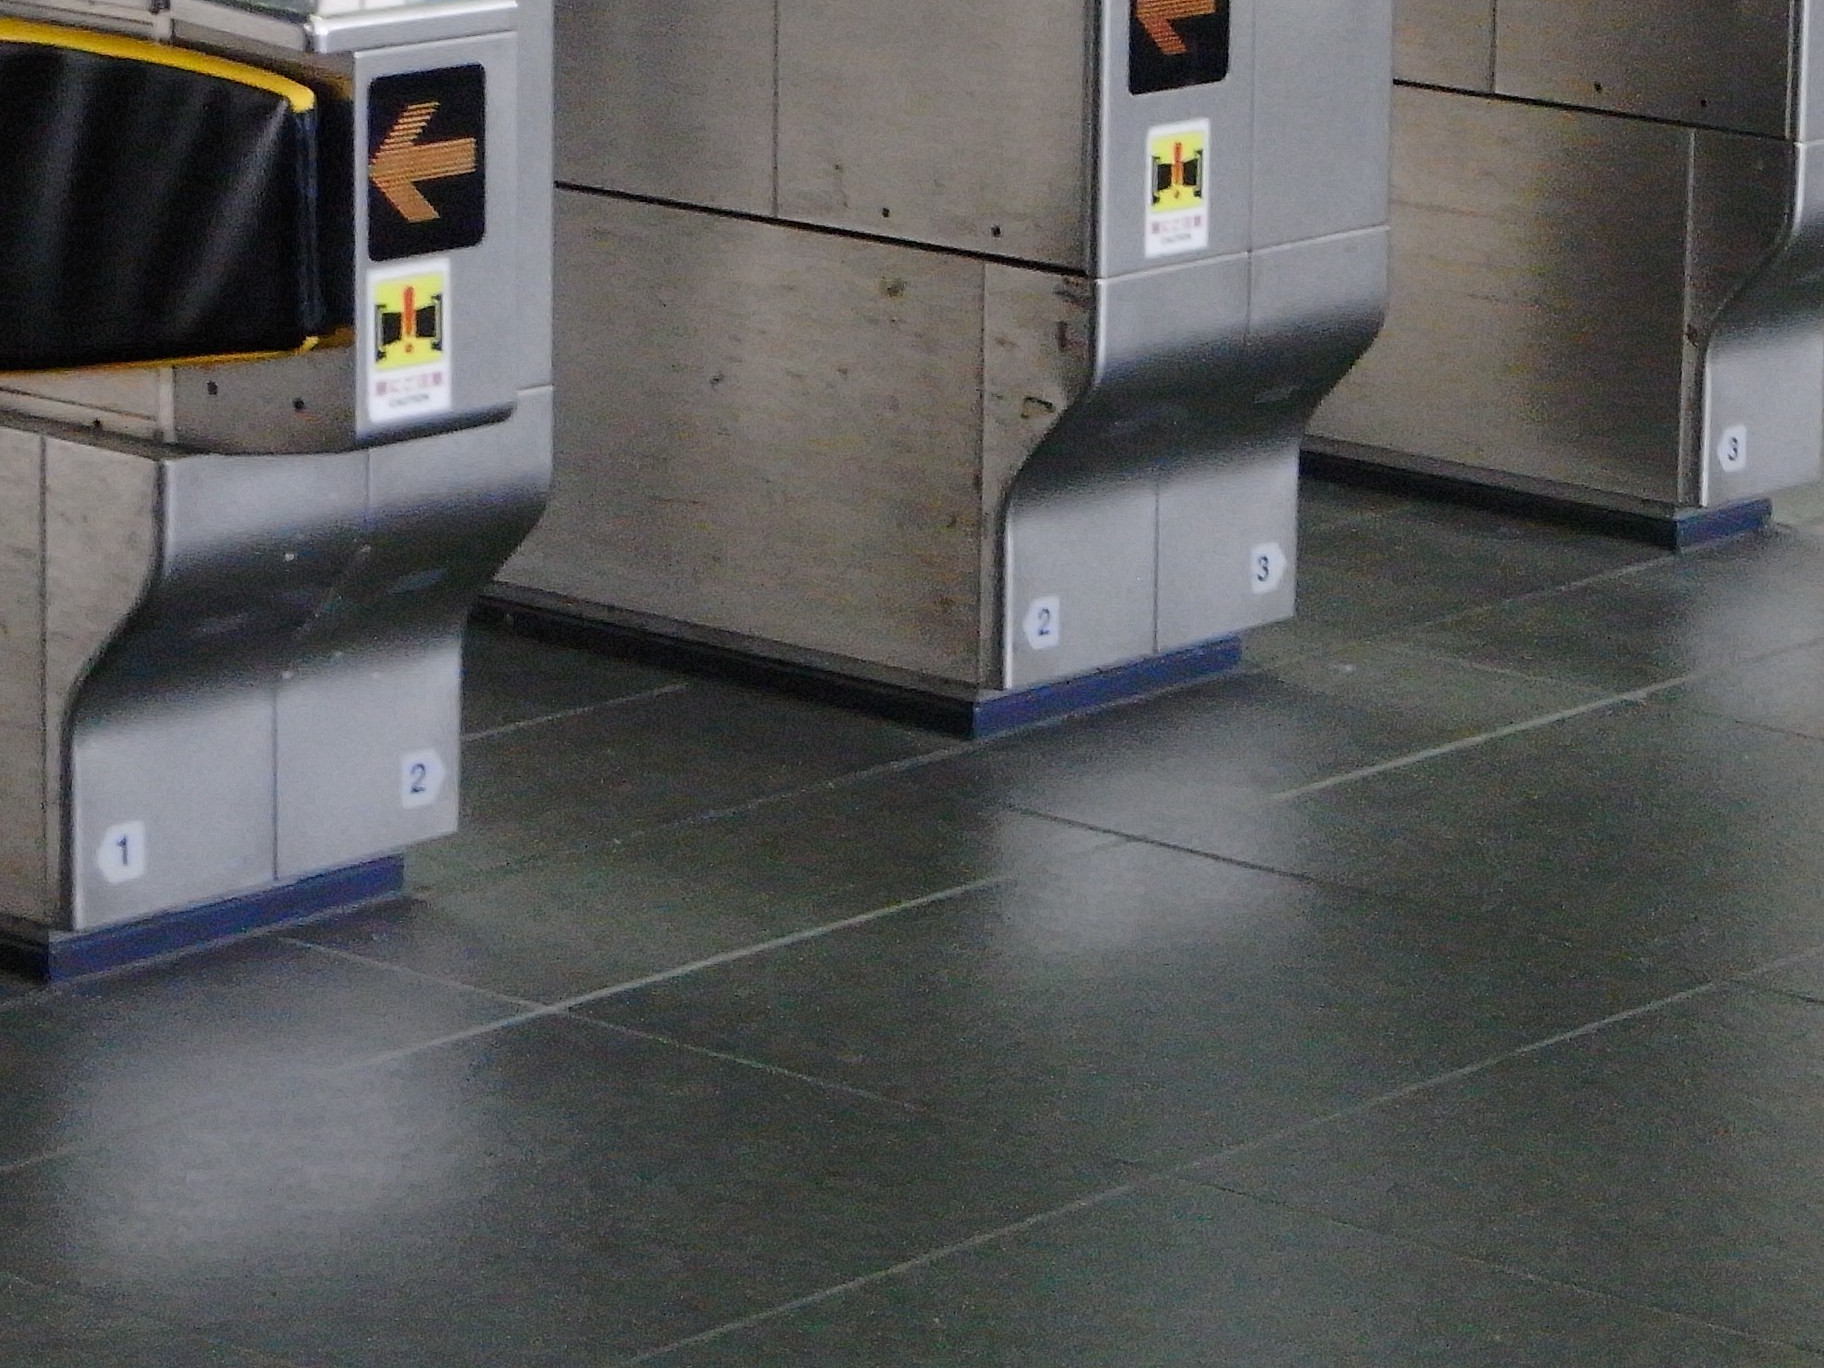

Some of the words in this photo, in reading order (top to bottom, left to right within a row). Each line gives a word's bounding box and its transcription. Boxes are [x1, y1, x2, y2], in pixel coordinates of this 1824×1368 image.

[1727, 436, 1739, 462] 3
[1256, 555, 1270, 583] 3
[1037, 607, 1051, 637] 2
[409, 762, 427, 795] 2
[115, 835, 129, 867] 1
